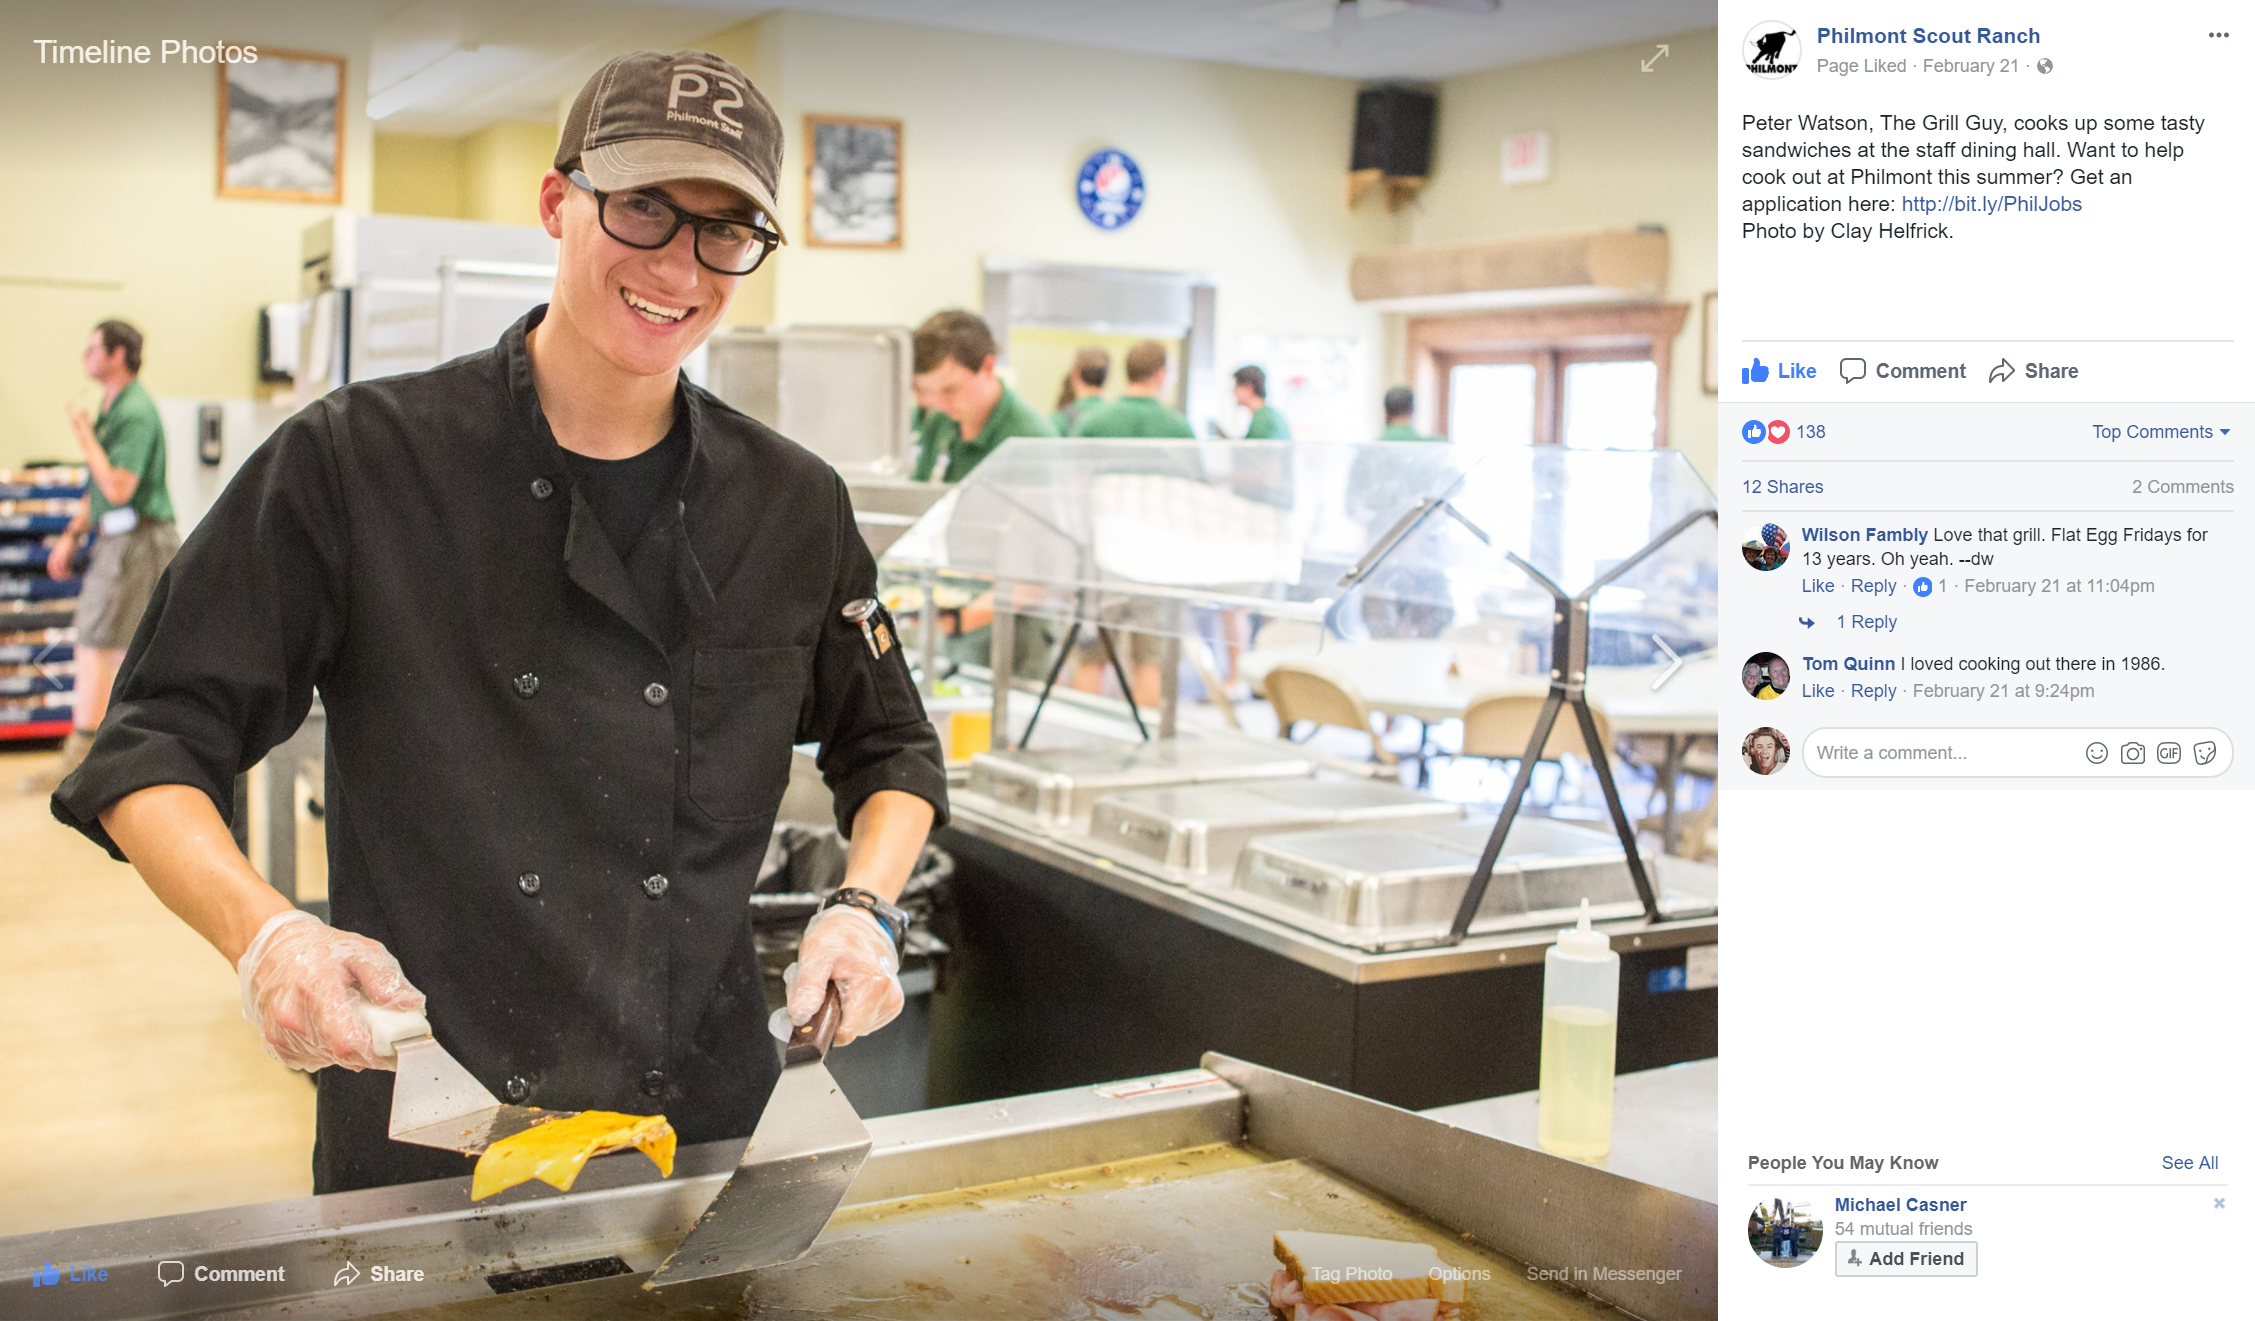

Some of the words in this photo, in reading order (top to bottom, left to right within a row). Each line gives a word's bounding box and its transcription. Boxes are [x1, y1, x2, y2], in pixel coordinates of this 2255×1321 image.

[1818, 28, 1907, 43] Philmont
[1913, 28, 1971, 43] Scout
[1978, 28, 2040, 43] Ranch
[1818, 59, 1858, 76] Page
[1865, 59, 1906, 72] Liked
[1924, 59, 1995, 76] February
[2000, 59, 2017, 72] 21
[666, 110, 720, 130] Philmont
[720, 122, 743, 140] Staff
[1743, 115, 1792, 130] Peter
[1798, 115, 1873, 133] Watson,
[1880, 115, 1915, 130] The
[1923, 115, 1958, 130] Grill
[1966, 115, 2006, 134] Guy,
[2014, 115, 2068, 130] cooks
[2075, 119, 2097, 134] up
[2104, 119, 2154, 130] some
[2161, 115, 2205, 134] tasty
[1742, 142, 1851, 157] sandwiches
[1858, 142, 1875, 157] at
[1881, 142, 1909, 157] the
[1916, 142, 1956, 157] staff
[1961, 142, 2016, 161] dining
[2024, 142, 2060, 157] hall.
[2067, 142, 2115, 157] Want
[2121, 142, 2138, 157] to
[2146, 142, 2184, 161] help
[1742, 169, 1786, 184] cook
[1792, 169, 1821, 184] out
[1828, 169, 1845, 184] at
[1852, 169, 1932, 184] Philmont
[1938, 169, 1970, 184] this
[1977, 169, 2063, 184] summer?
[2071, 169, 2104, 184] Get
[2110, 173, 2131, 184] an
[1742, 196, 1841, 215] application
[1849, 196, 1894, 211] here:
[1903, 196, 2082, 215] http://bit.ly/PhilJobs
[1743, 223, 1796, 238] Photo
[1804, 223, 1825, 242] by
[1831, 223, 1872, 242] Clay
[1880, 223, 1953, 238] Helfrick.
[1779, 363, 1816, 378] Like
[1876, 363, 1966, 378] Comment
[2025, 363, 2078, 378] Share
[1797, 425, 1825, 438] 138
[2093, 425, 2121, 442] Top
[2127, 425, 2213, 438] Comments
[1743, 480, 1761, 493] 12
[1768, 480, 1823, 493] Shares
[2133, 480, 2141, 493] 2
[2148, 480, 2234, 493] Comments
[1802, 528, 1860, 541] Wilson
[1867, 528, 1928, 545] Fambly
[1935, 528, 1972, 541] Love
[1978, 528, 2008, 541] that
[2013, 528, 2045, 545] grill.
[2052, 528, 2081, 541] Flat
[2087, 528, 2117, 545] Egg
[2124, 528, 2181, 545] Fridays
[2187, 528, 2208, 541] for
[1803, 552, 1821, 565] 13
[1827, 555, 1875, 569] years.
[1881, 552, 1904, 565] Oh
[1910, 552, 1953, 569] yeah.
[1959, 552, 1994, 565] --dw
[1802, 579, 1834, 592] Like
[1852, 579, 1897, 596] Reply
[1939, 579, 1946, 592] 1
[1966, 579, 2036, 596] February
[2042, 579, 2058, 592] 21
[2067, 579, 2081, 592] at
[2088, 579, 2154, 596] 11:04pm
[1837, 615, 1844, 628] 1
[1853, 615, 1897, 632] Reply
[1803, 657, 1838, 670] Tom
[1844, 657, 1895, 671] Quinn
[1901, 656, 1905, 671] I
[1911, 657, 1952, 670] loved
[1959, 657, 2020, 674] cooking
[2026, 657, 2051, 670] out
[2056, 657, 2096, 670] there
[2102, 657, 2115, 670] in
[2122, 657, 2164, 670] 1986.
[1802, 684, 1834, 697] Like
[1852, 684, 1897, 701] Reply
[1914, 684, 1985, 701] February
[1990, 684, 2007, 697] 21
[2015, 684, 2030, 697] at
[2036, 684, 2094, 701] 9:24pm
[1817, 746, 1858, 759] Write
[1864, 749, 1873, 759] a
[1879, 746, 1966, 759] comment...
[2160, 747, 2178, 759] GIF
[1749, 1156, 1806, 1173] People
[1812, 1156, 1843, 1169] You
[1851, 1156, 1884, 1173] May
[1891, 1156, 1939, 1169] Know
[2162, 1156, 2193, 1169] See
[2199, 1156, 2218, 1169] All
[1836, 1198, 1900, 1211] Michael
[1906, 1198, 1967, 1211] Casner
[1836, 1222, 1854, 1235] 54
[1861, 1222, 1913, 1235] mutual
[1919, 1222, 1972, 1235] friends
[1869, 1252, 1903, 1265] Add
[1911, 1252, 1963, 1265] Friend
